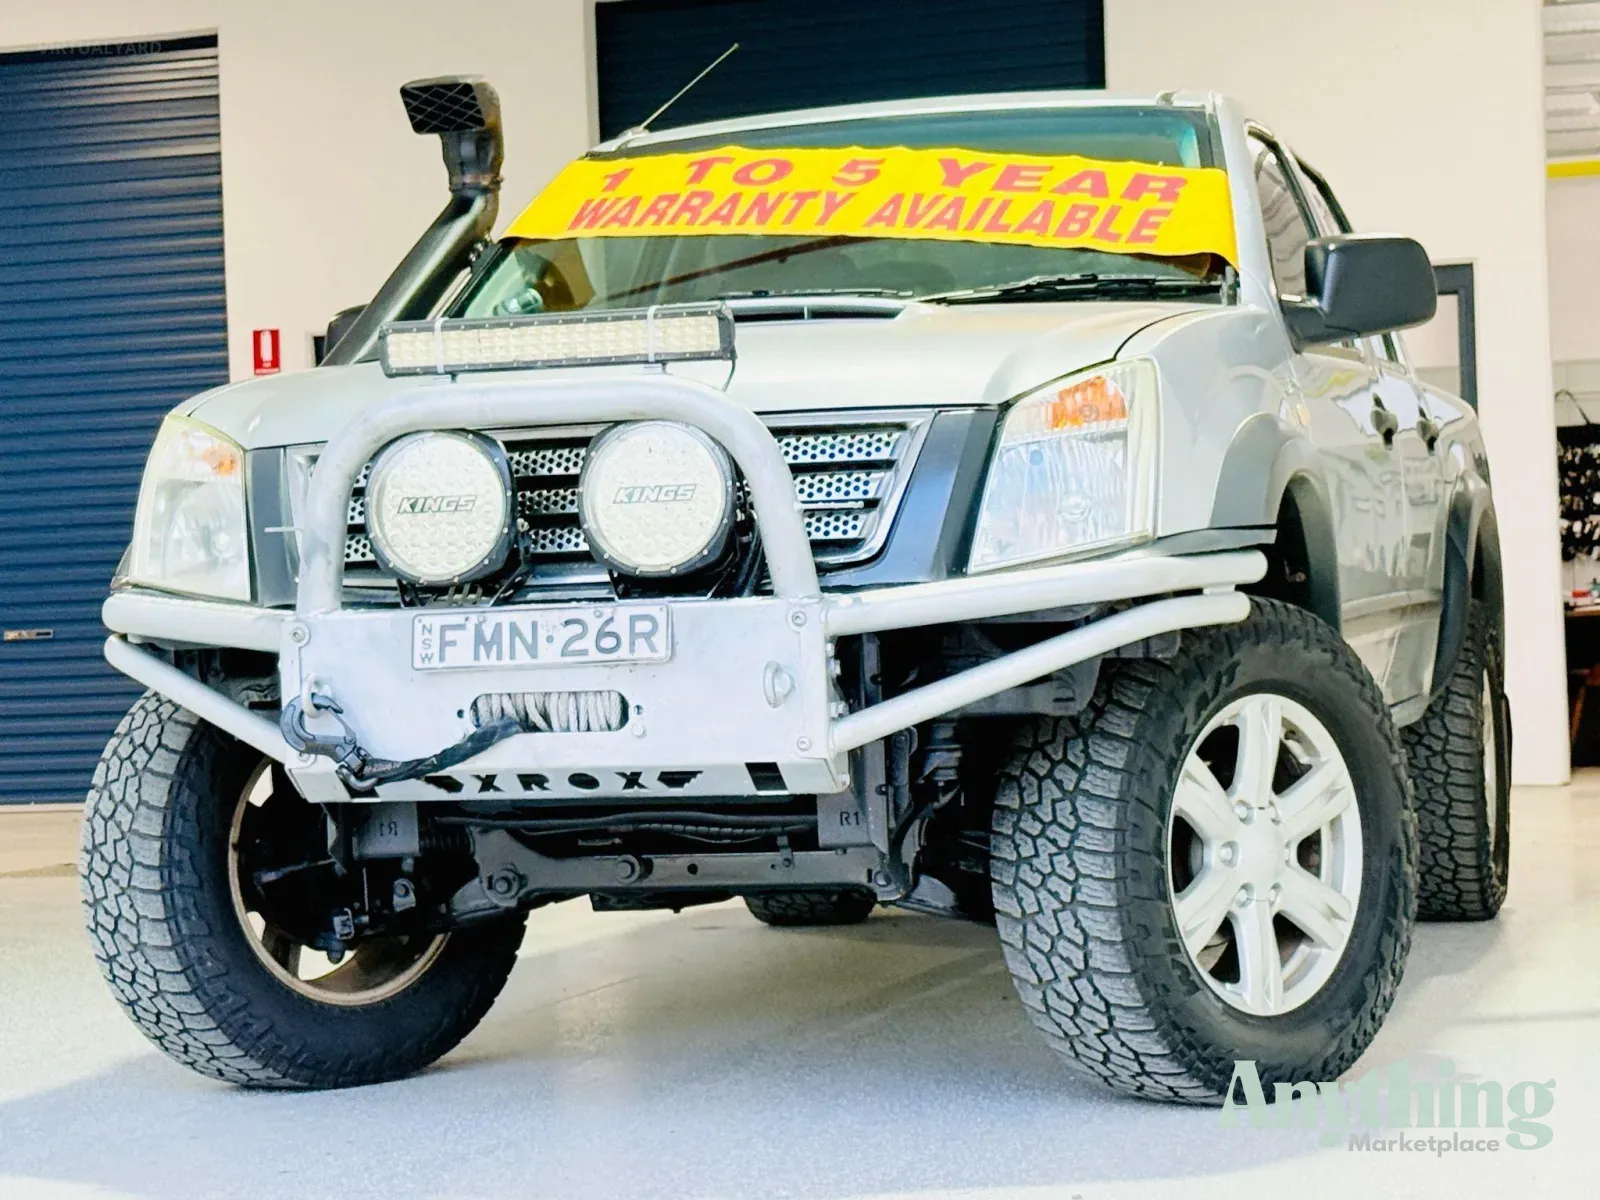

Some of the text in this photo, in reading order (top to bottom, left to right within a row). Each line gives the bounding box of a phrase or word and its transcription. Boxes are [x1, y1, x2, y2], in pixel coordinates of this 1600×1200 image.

[601, 156, 1188, 202] 1 TO 5 YEAR
[567, 190, 1173, 244] WARRANTY AVAILABLE
[397, 494, 478, 515] KINGS
[612, 483, 697, 505] KINGS
[839, 811, 860, 826] R1
